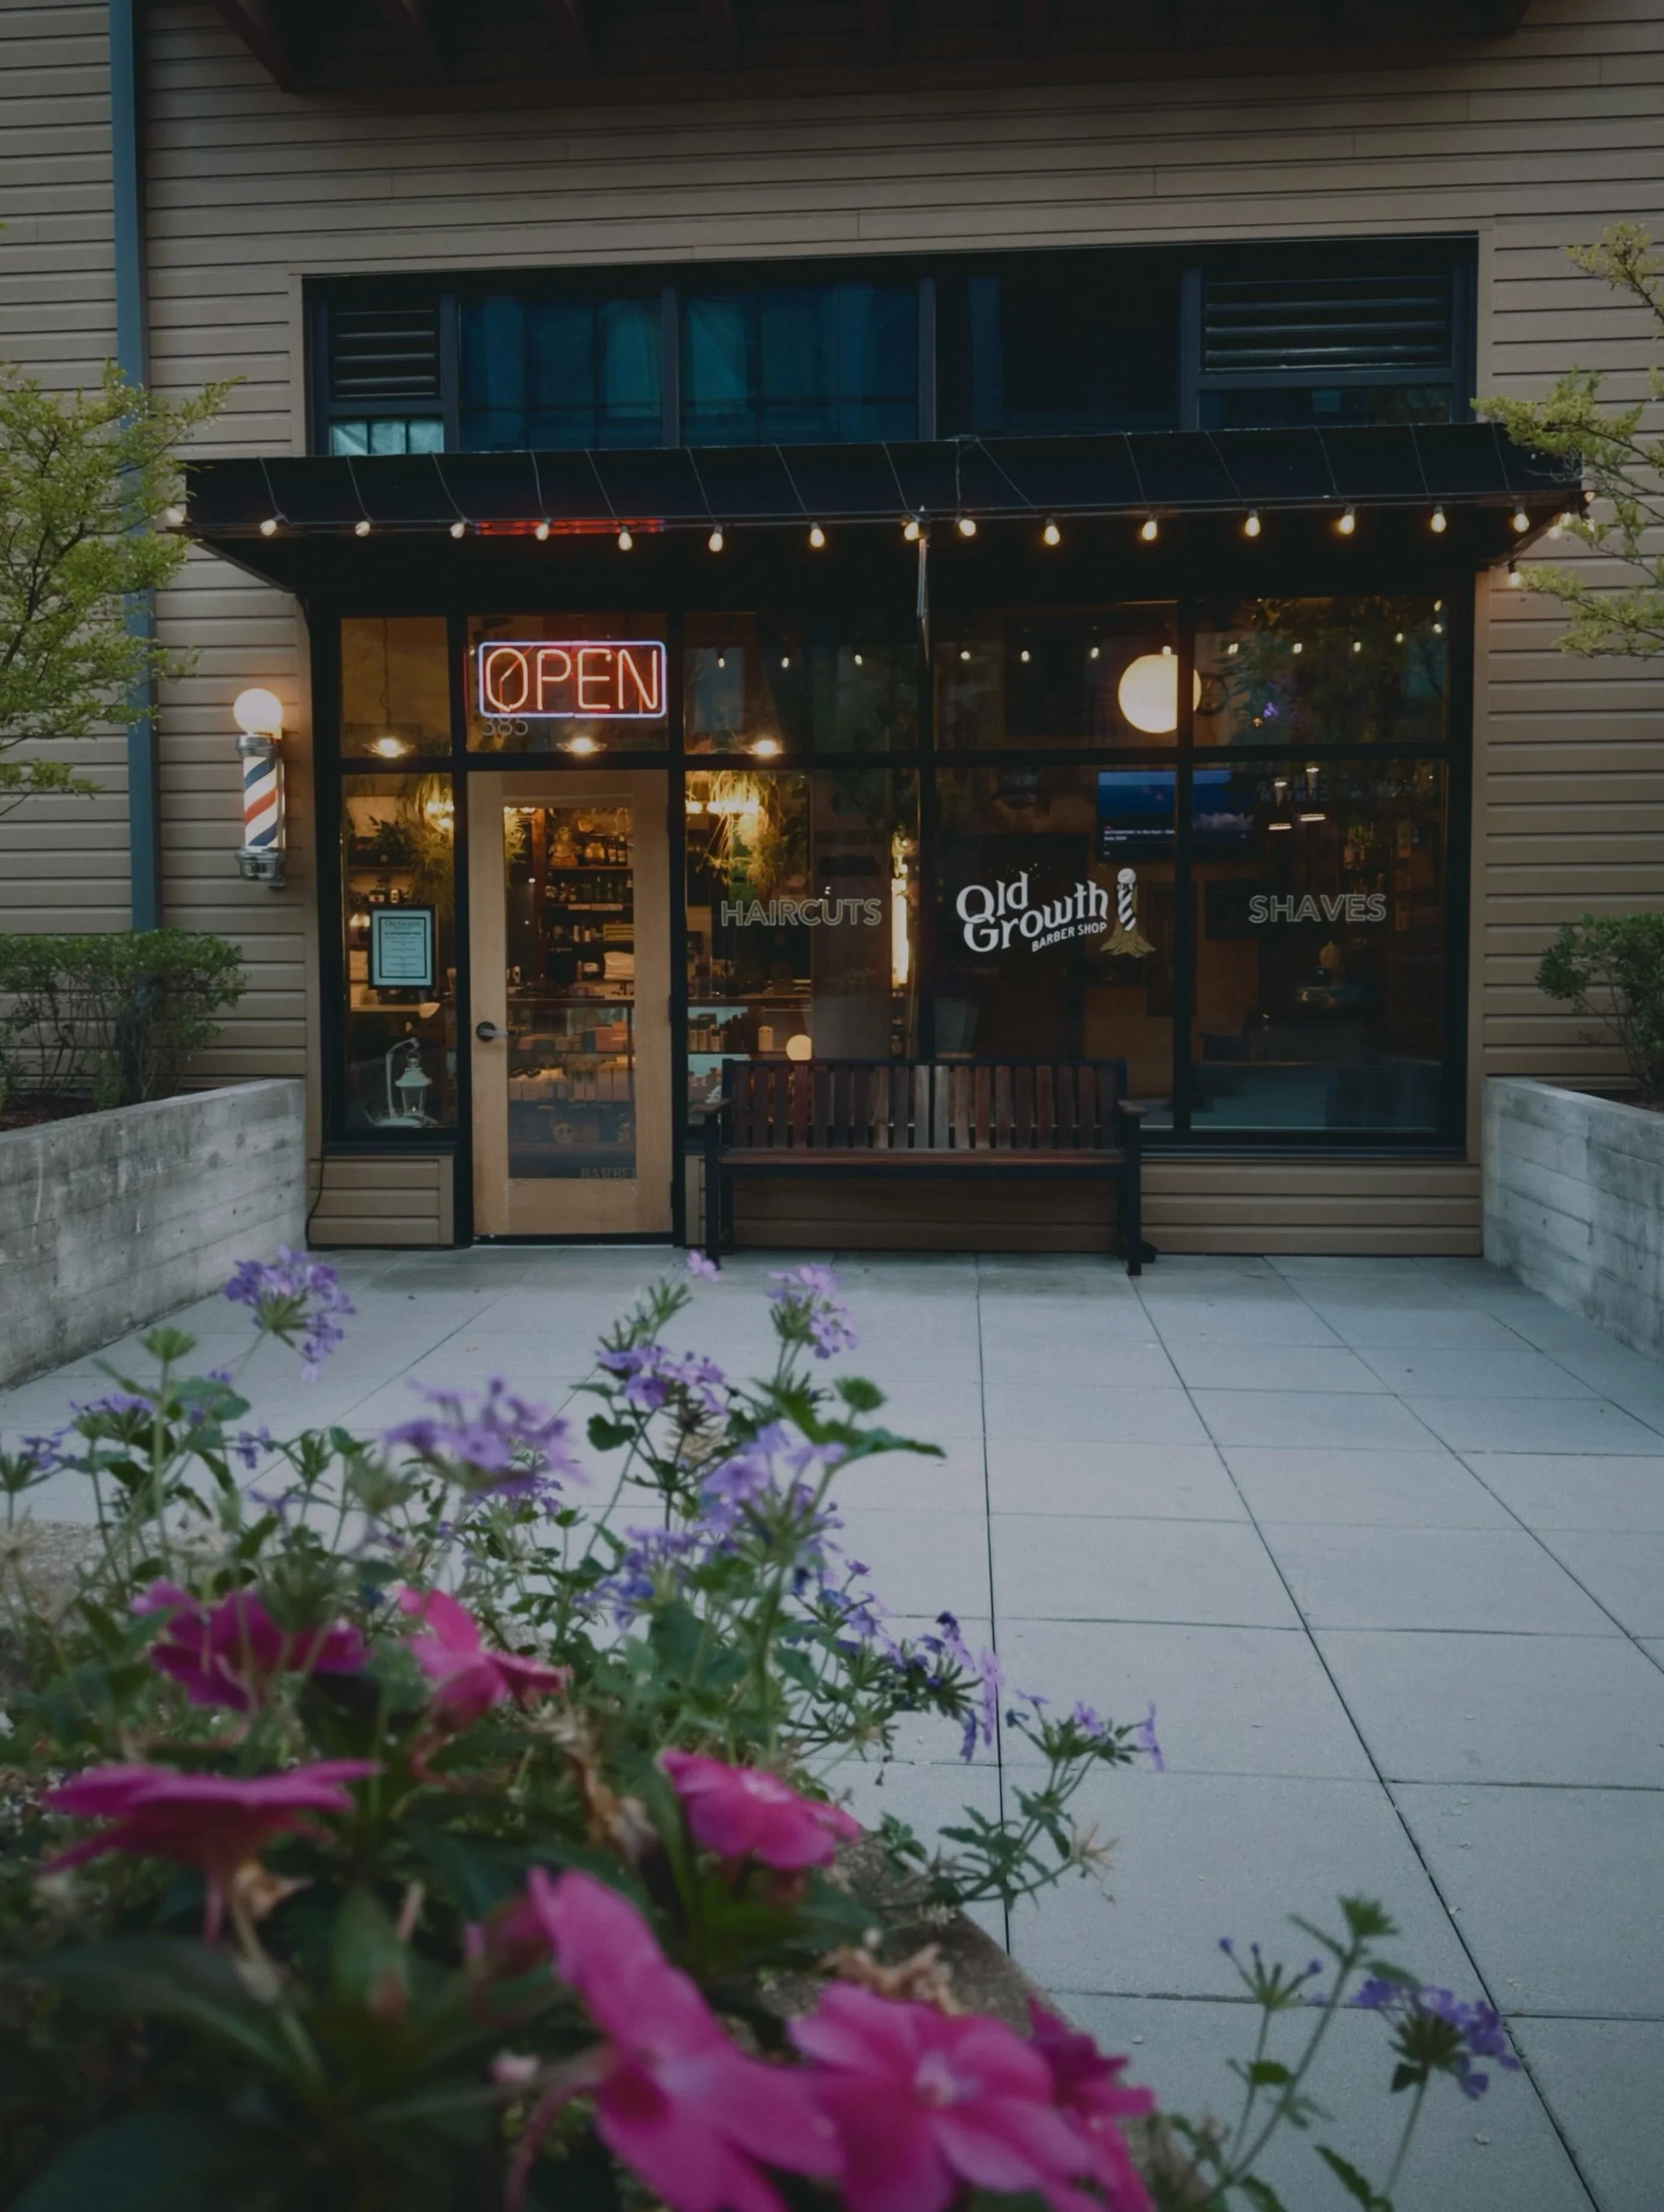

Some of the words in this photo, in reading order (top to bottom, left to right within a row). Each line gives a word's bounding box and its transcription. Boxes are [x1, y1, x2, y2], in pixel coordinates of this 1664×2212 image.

[486, 647, 658, 712] OPEN
[721, 898, 882, 926] HAIRCUTS
[956, 870, 1028, 924] Old
[963, 880, 1108, 952] Growth
[1248, 893, 1386, 923] SHAVES
[1032, 926, 1075, 952] BARBER
[1077, 922, 1108, 936] SHOP
